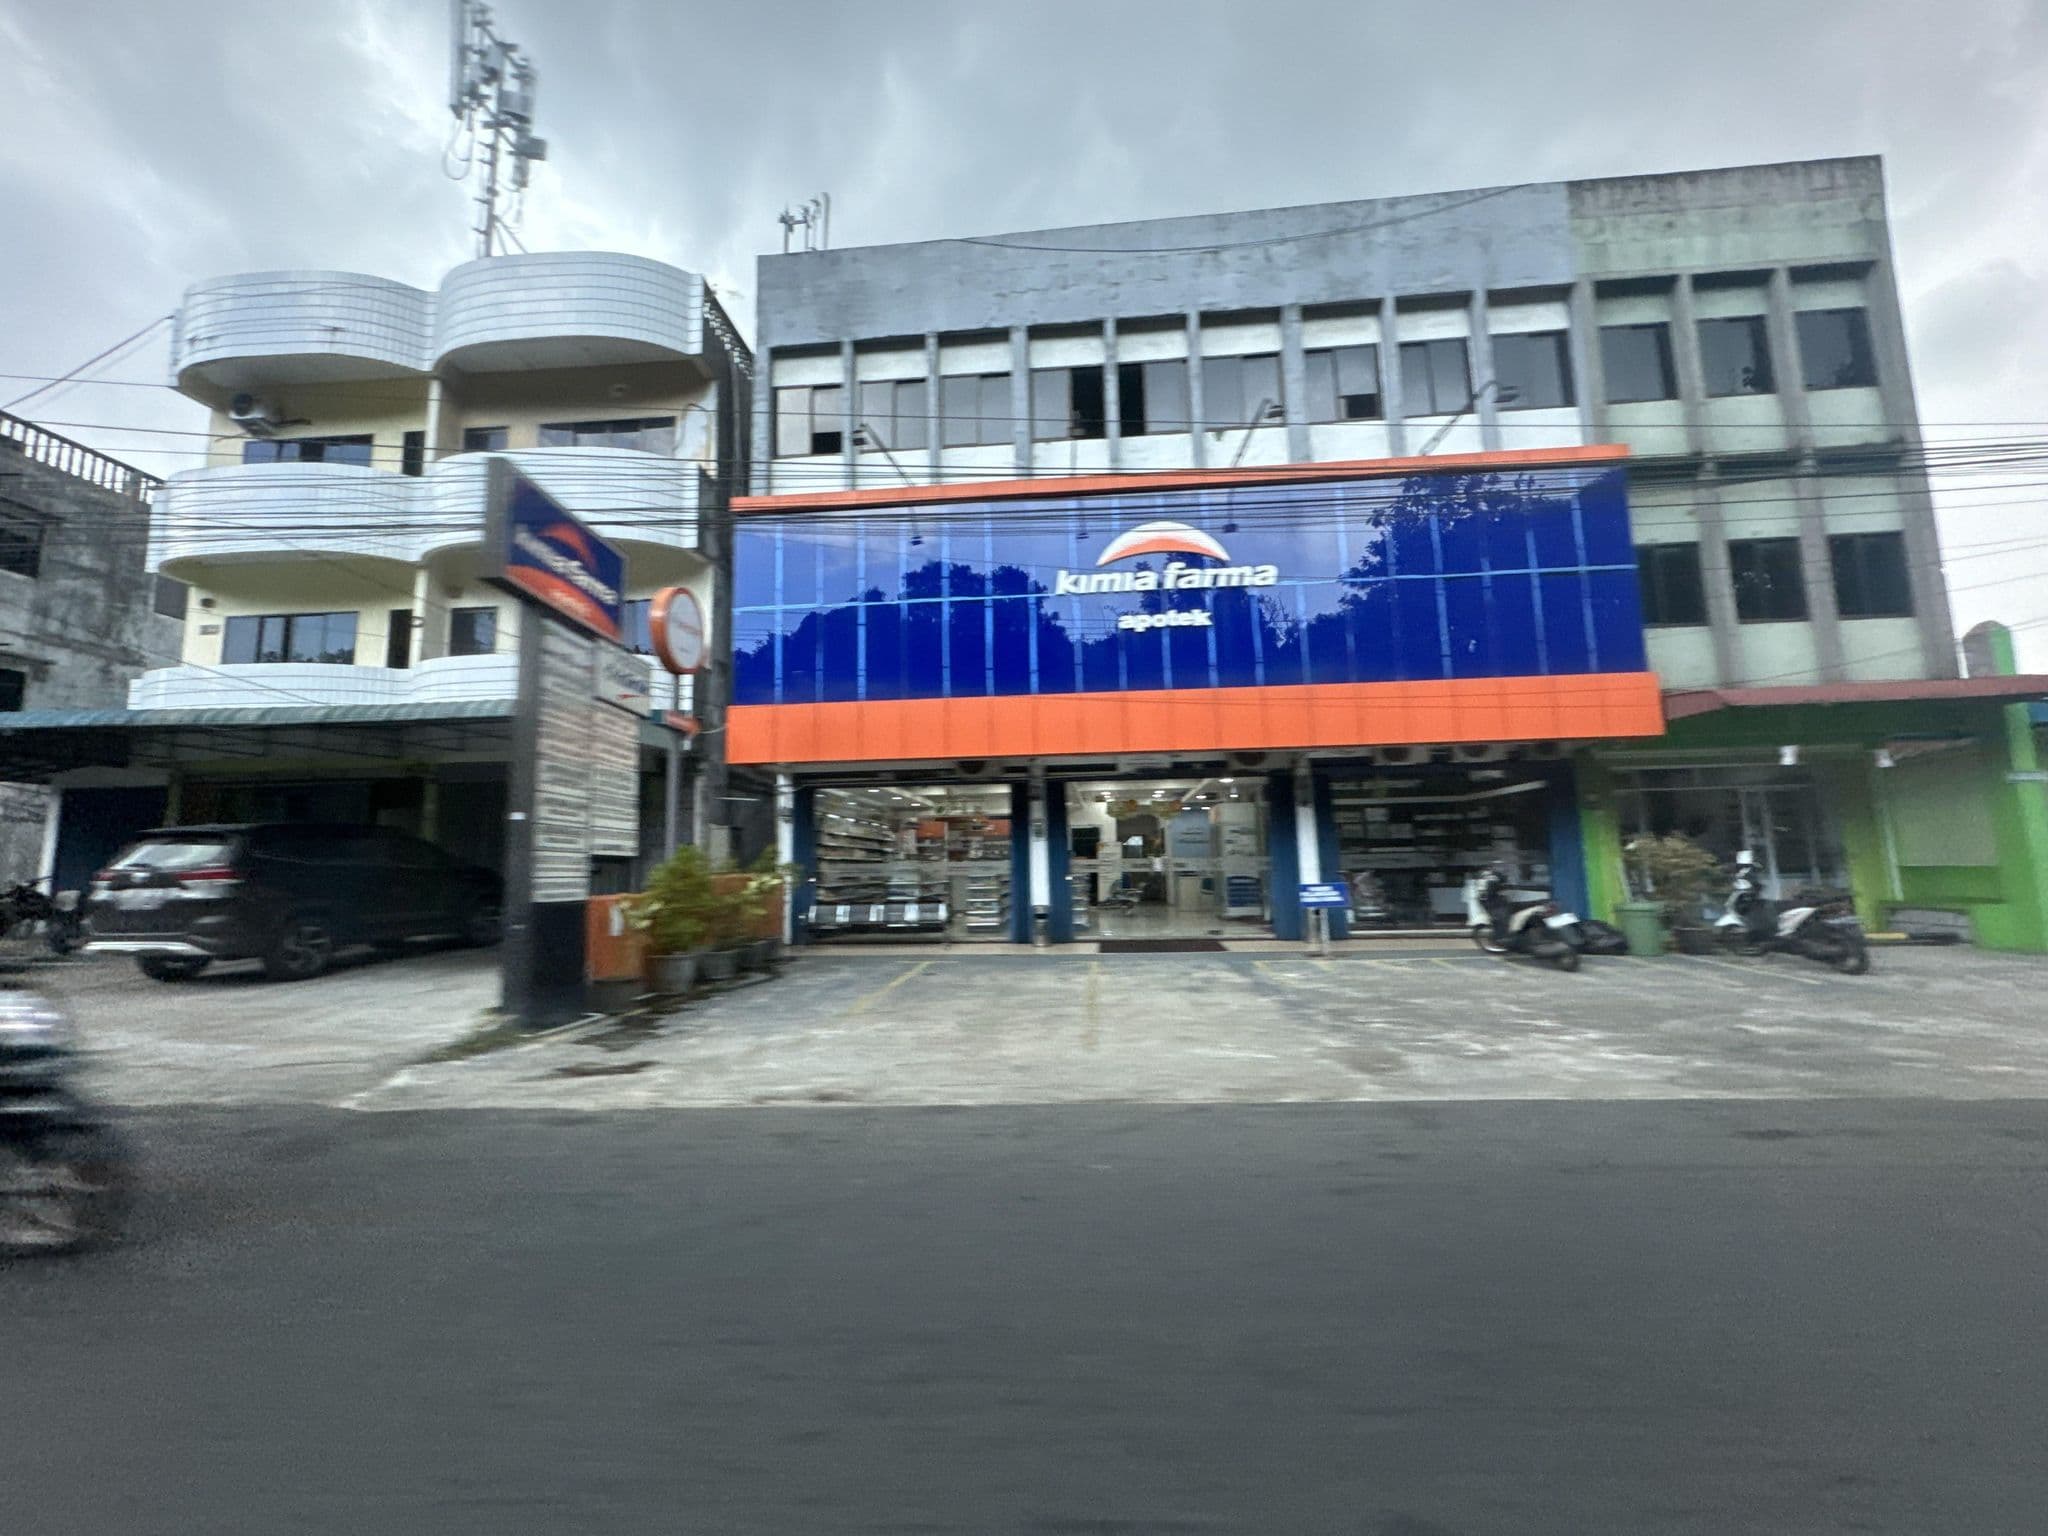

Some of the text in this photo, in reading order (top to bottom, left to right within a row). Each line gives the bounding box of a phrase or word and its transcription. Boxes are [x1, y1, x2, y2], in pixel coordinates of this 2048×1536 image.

[1056, 562, 1279, 594] kimia farma
[1118, 609, 1213, 632] apotek
